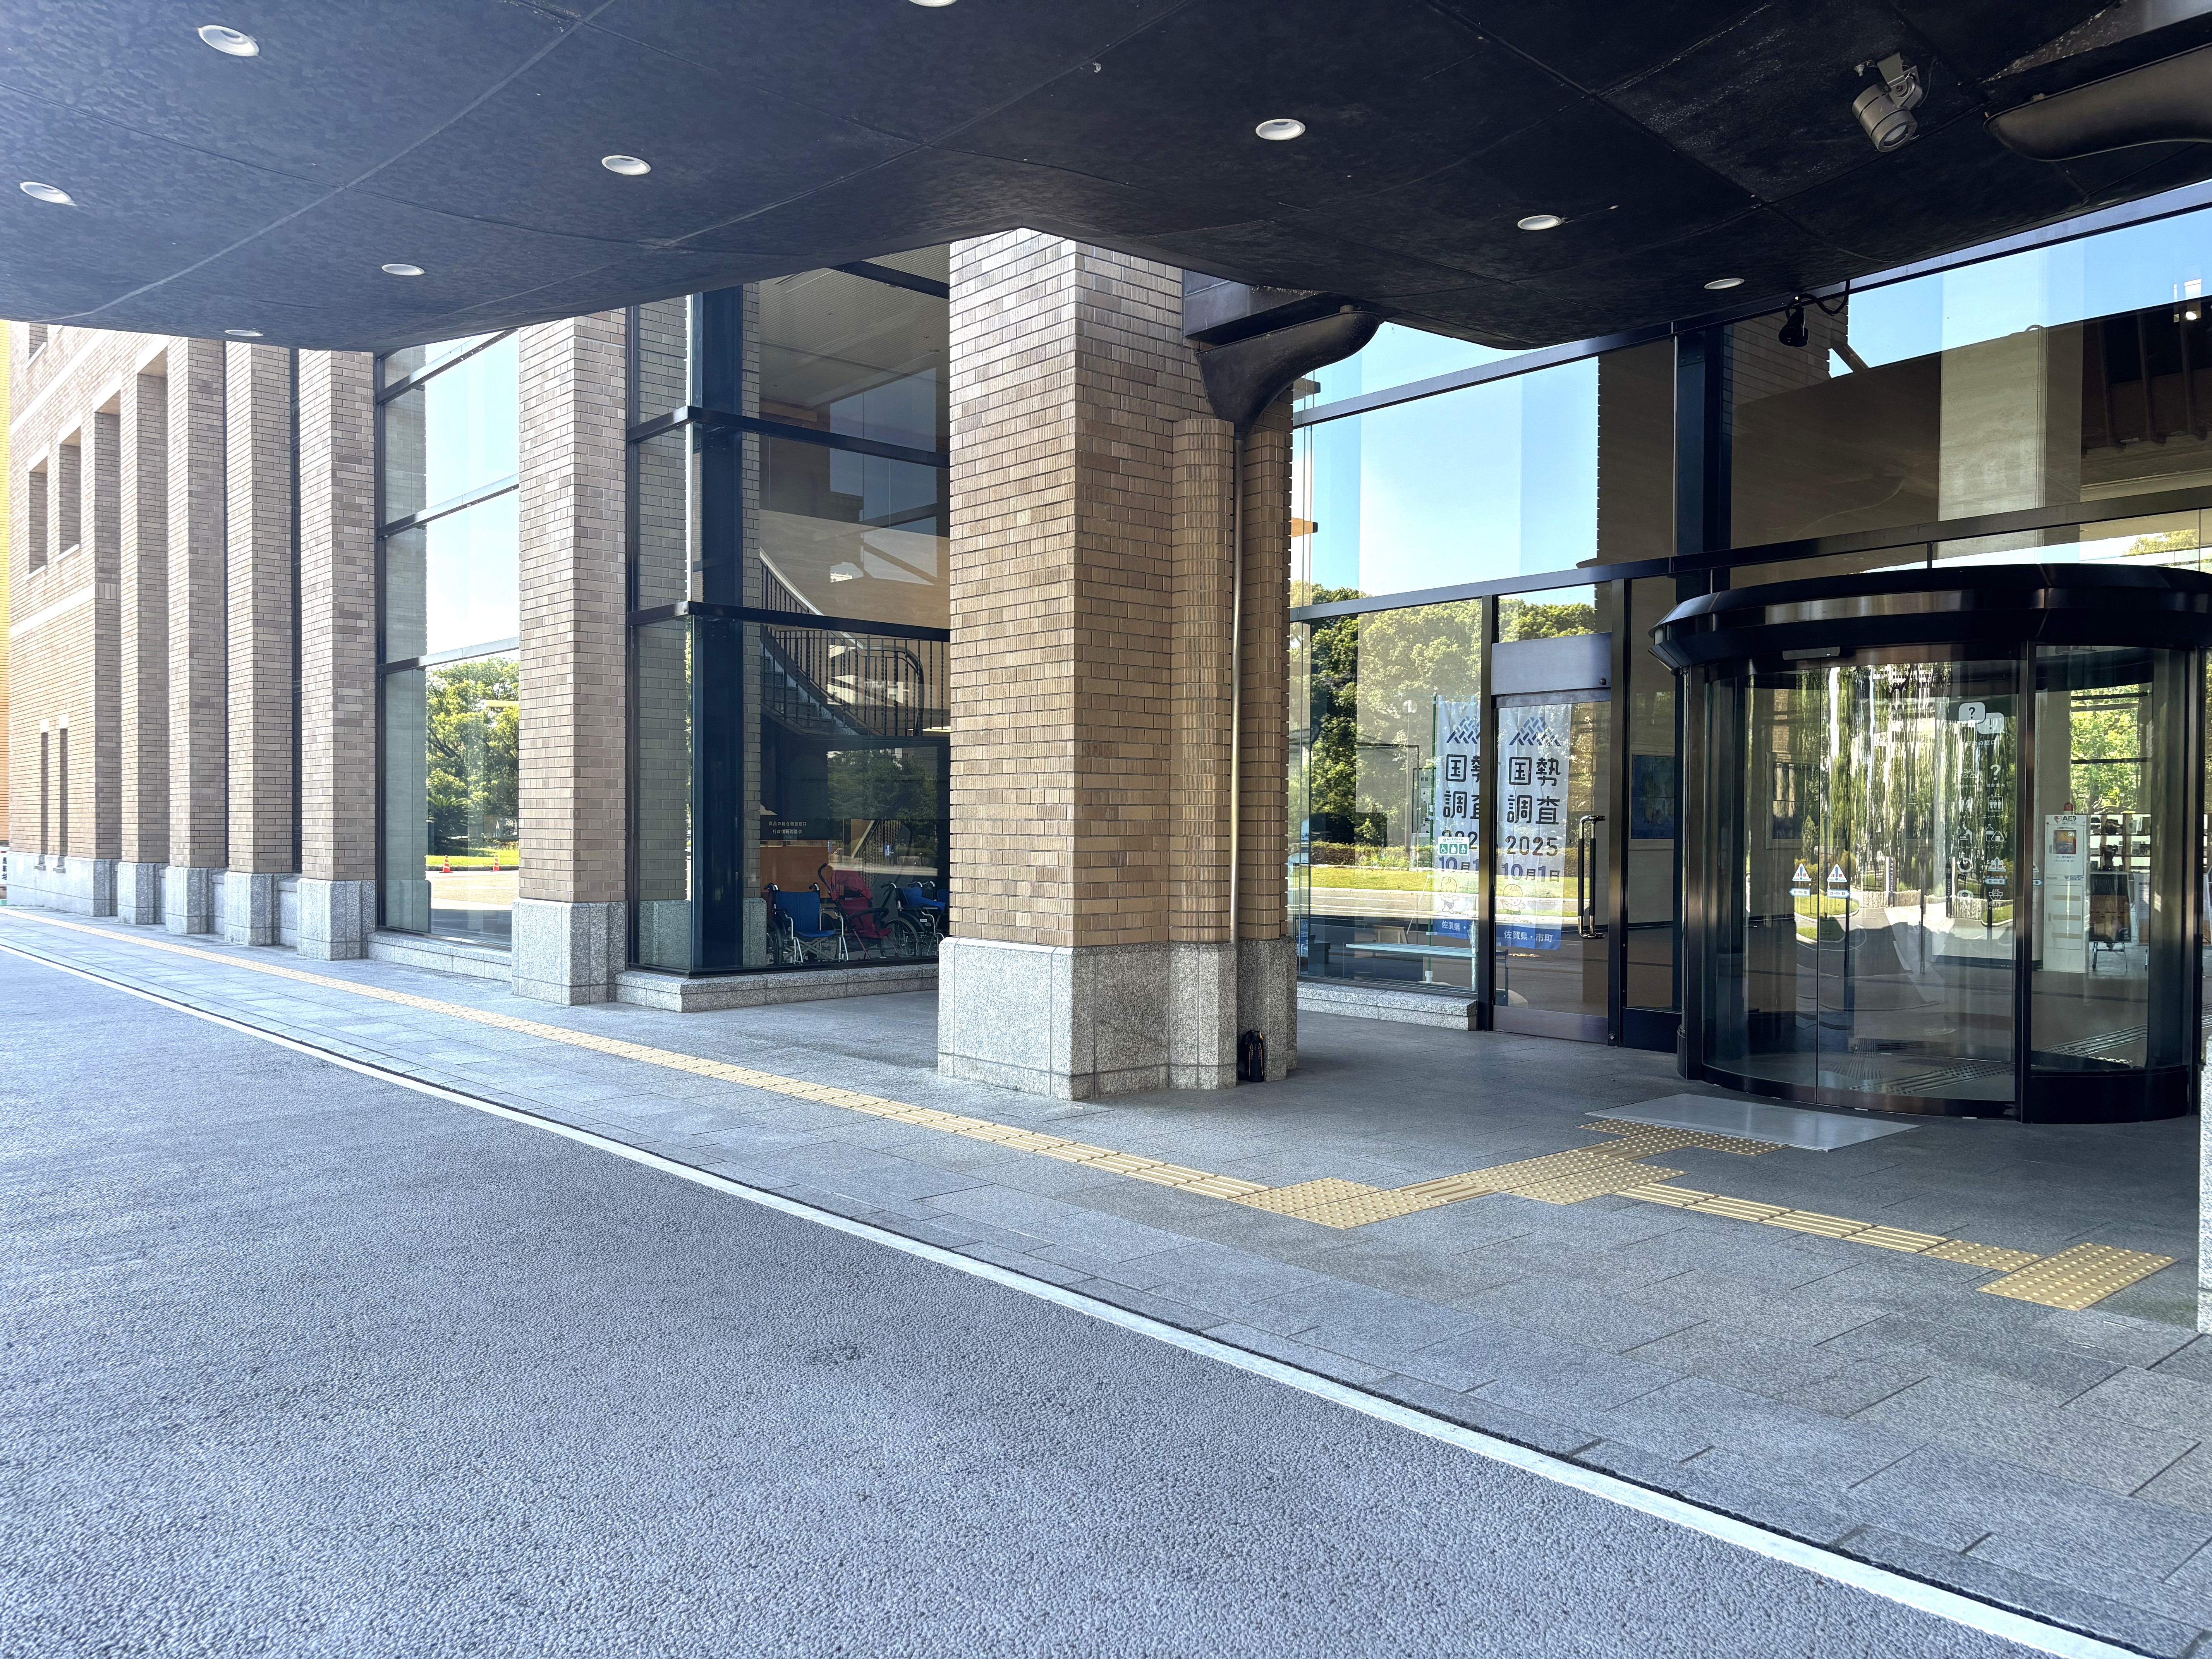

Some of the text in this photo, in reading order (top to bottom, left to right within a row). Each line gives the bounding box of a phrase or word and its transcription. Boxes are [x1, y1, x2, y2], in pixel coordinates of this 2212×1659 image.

[1509, 757, 1561, 786] 国勢
[1507, 794, 1560, 824] 調査
[1505, 835, 1558, 857] 2025
[1501, 863, 1560, 882] 10月1日
[1504, 930, 1553, 943] 佐賀県・市町
